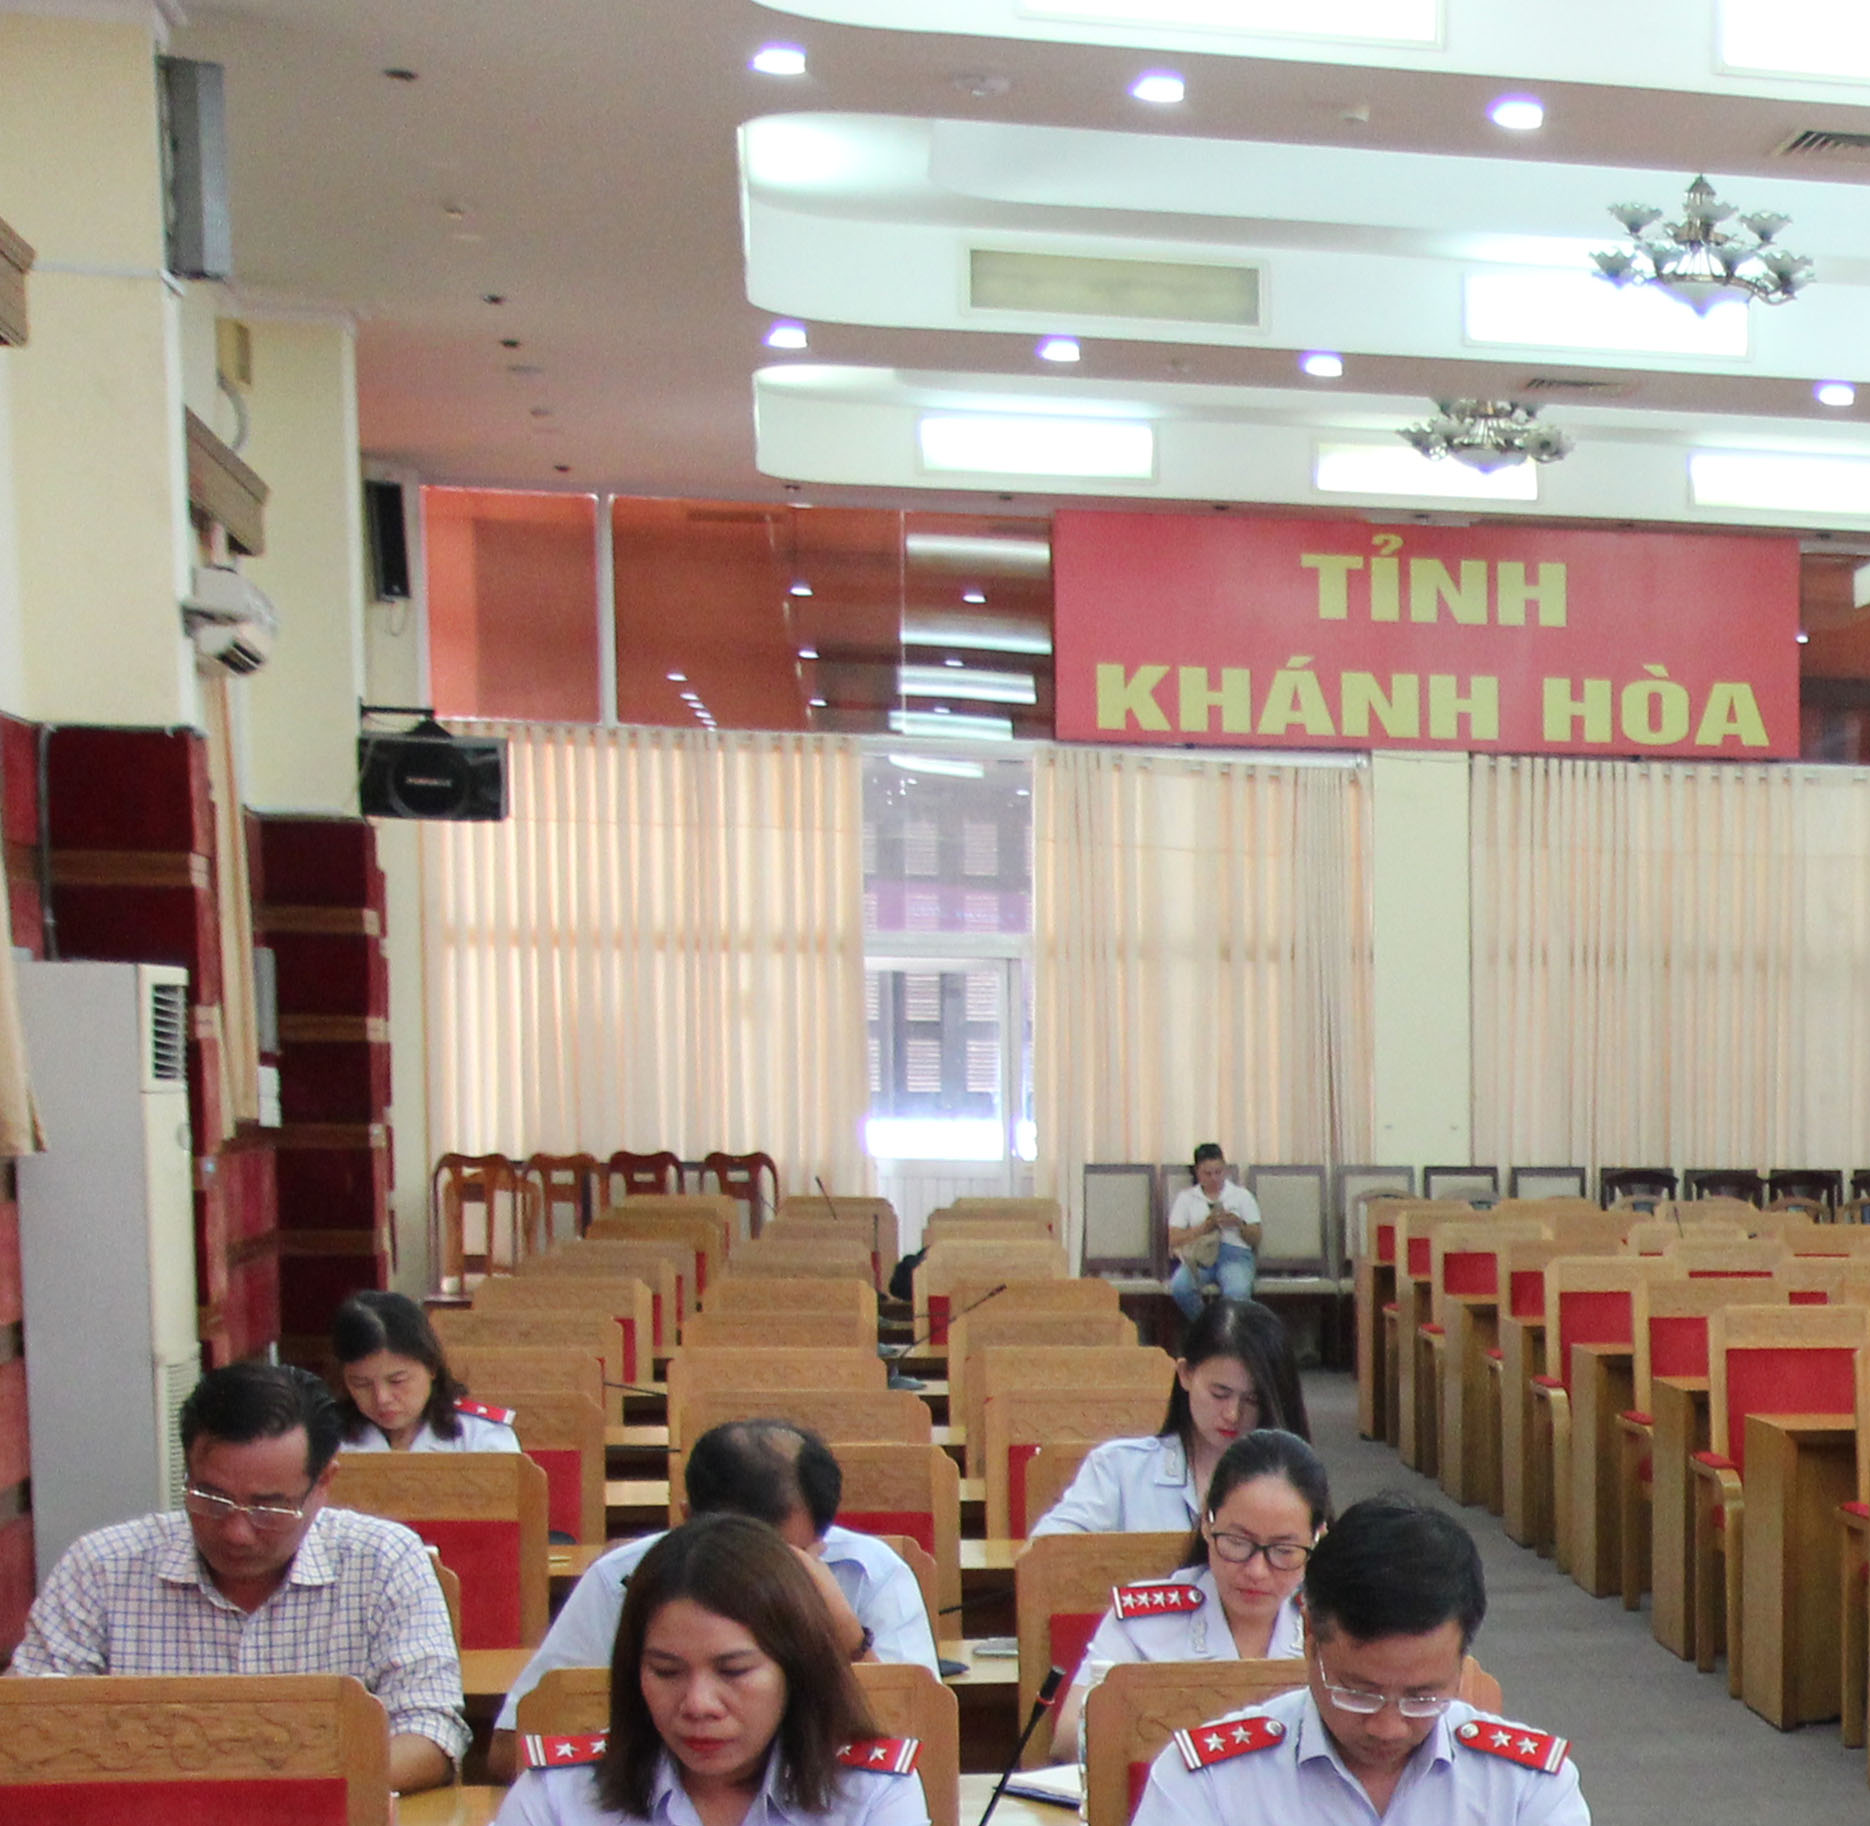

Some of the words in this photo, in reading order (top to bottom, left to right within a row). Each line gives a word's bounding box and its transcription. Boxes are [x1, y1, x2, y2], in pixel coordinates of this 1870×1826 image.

[1301, 534, 1567, 628] TỈNH
[1096, 656, 1500, 741] KHÁNH
[1543, 664, 1770, 748] HÒA
